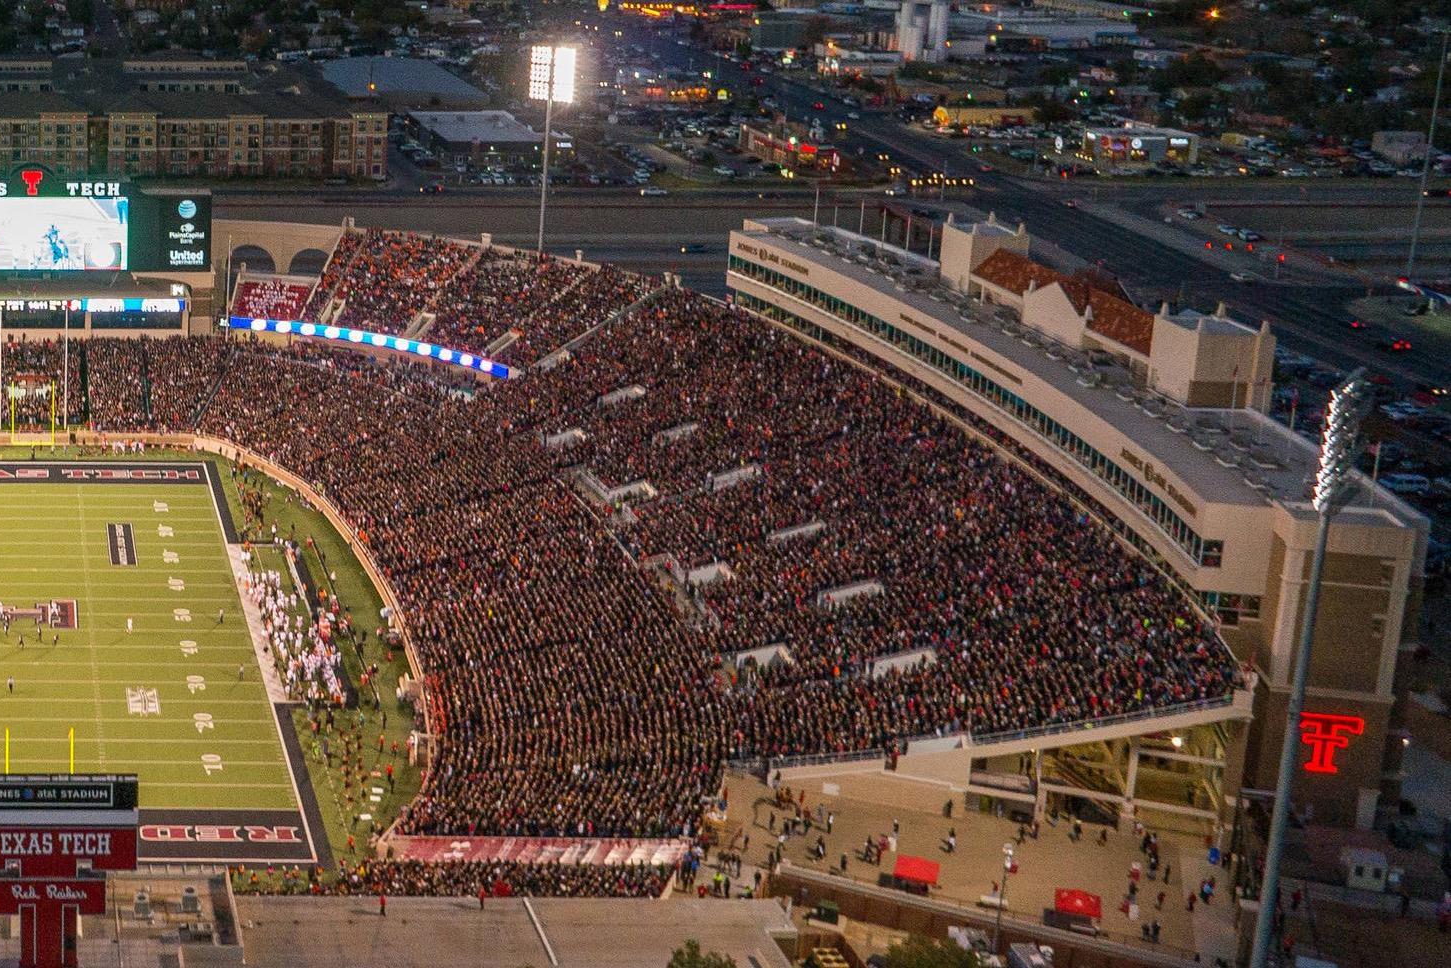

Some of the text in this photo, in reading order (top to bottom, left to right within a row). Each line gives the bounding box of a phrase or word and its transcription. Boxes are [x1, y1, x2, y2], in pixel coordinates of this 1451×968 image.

[66, 182, 120, 196] TECH
[170, 250, 204, 261] United
[61, 469, 200, 479] TECH
[60, 789, 108, 799] STADIUM
[139, 824, 302, 843] RED
[58, 832, 111, 855] TECH
[11, 884, 87, 899] Red Raiders
